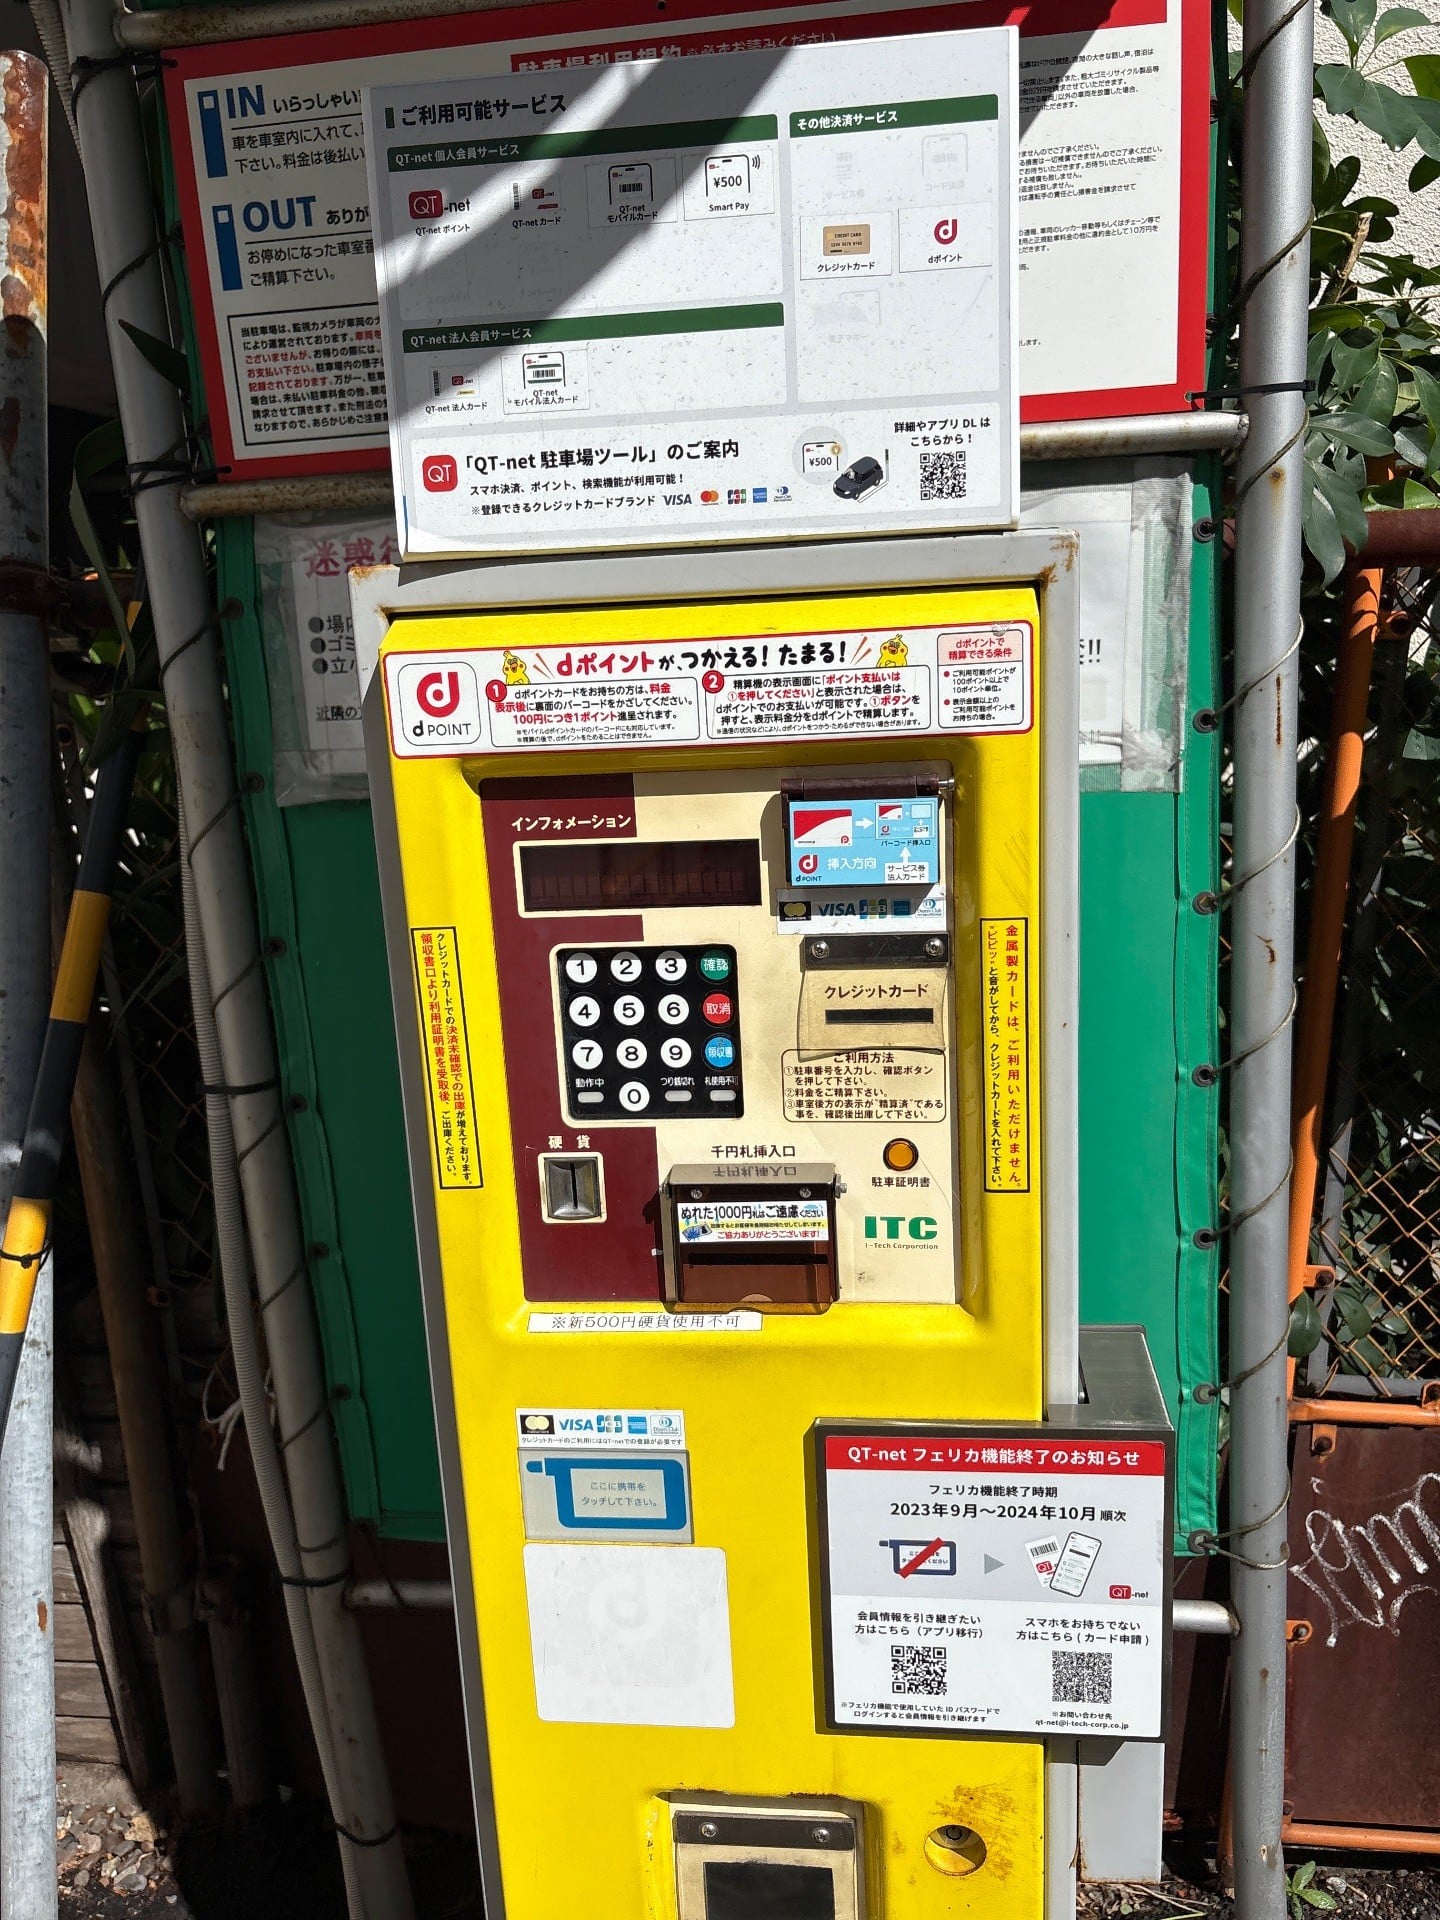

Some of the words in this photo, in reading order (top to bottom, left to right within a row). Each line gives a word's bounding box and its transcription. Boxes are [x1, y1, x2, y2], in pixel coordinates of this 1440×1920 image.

[226, 85, 266, 119] IN
[401, 94, 567, 127] ご利用可能サービス
[797, 110, 899, 130] その他決済サービス
[395, 152, 433, 167] QT-net
[435, 144, 520, 163] 個人会員サービス
[713, 175, 743, 188] ¥500
[619, 204, 646, 214] QT-net
[708, 202, 733, 212] Smart
[735, 202, 750, 211] Pay
[243, 196, 316, 232] OUT
[607, 211, 658, 223] モバイルカード
[512, 218, 538, 229] QT-net
[539, 215, 561, 227] カード
[415, 226, 442, 237] QT-net
[442, 224, 471, 234] ポイント
[928, 253, 963, 264] dポイント
[817, 261, 876, 272] クレジットカード
[251, 269, 335, 287] ご精算下さい。
[410, 335, 447, 348] QT-net
[448, 328, 532, 344] 法人会員サービス
[532, 389, 558, 398] QT-net
[425, 404, 451, 414] QT-net
[452, 401, 488, 412] 法人カード
[513, 395, 579, 407] モバイル法人カード
[808, 456, 833, 467] ¥500
[663, 494, 692, 506] VISA
[956, 637, 1005, 649] dポイントで
[948, 647, 1013, 661] 精算できる条件
[331, 657, 355, 675] 立
[733, 671, 901, 690] 精算機の表示画面に「ポイント支払いは
[514, 683, 671, 700] dポイントカードをお持ちの方は、料金
[495, 696, 694, 714] 表示後に裏面のバーコードをかざしてください。
[513, 711, 678, 725] 100円につき1ポイント進呈されます。
[428, 723, 472, 737] POINT
[511, 814, 632, 832] インフォメーション
[827, 856, 877, 870] 挿入方向
[887, 864, 926, 872] サービス券
[887, 873, 926, 881] 法人カード
[818, 903, 857, 917] VISA
[576, 960, 585, 976] 1
[619, 959, 634, 975] 2
[664, 958, 679, 974] 3
[703, 958, 729, 971] 確認
[824, 983, 930, 999] クレジットカード
[577, 1003, 592, 1019] 4
[621, 1002, 636, 1019] 5
[666, 1001, 681, 1018] 6
[706, 1002, 731, 1015] 取消
[580, 1046, 594, 1062] 7
[624, 1045, 639, 1061] 8
[669, 1045, 683, 1061] 9
[833, 1052, 895, 1064] ご利用方法
[575, 1077, 605, 1088] 動作中
[660, 1076, 695, 1086] つり銭切れ
[794, 1076, 868, 1086] を押して下さい。
[795, 1109, 929, 1120] 事を、確認後出庫して下さい。
[711, 1145, 796, 1159] 千円札挿入口
[871, 1176, 931, 1188] 駐車証明書
[864, 1215, 938, 1240] ITC
[892, 1242, 939, 1250] Corporation
[552, 1314, 741, 1329] ※新500円硬貨使用不可
[559, 1418, 594, 1431] VISA
[848, 1446, 907, 1465] QT-net
[912, 1447, 1141, 1467] フェリカ機能終了のお知らせ
[590, 1481, 646, 1492] ここに携帯を
[929, 1484, 1058, 1498] フェリカ機能終了時期
[581, 1496, 658, 1508] タッチして下さい。
[1100, 1509, 1127, 1522] 順次
[857, 1610, 981, 1625] 会員情報を引き継ぎたい
[1025, 1617, 1141, 1631] スマホをお持ちでない
[853, 1711, 988, 1724] ログインすると会員情報を引き継げます
[1035, 1718, 1129, 1730] qt-net@i-tech-corp.co.jp
